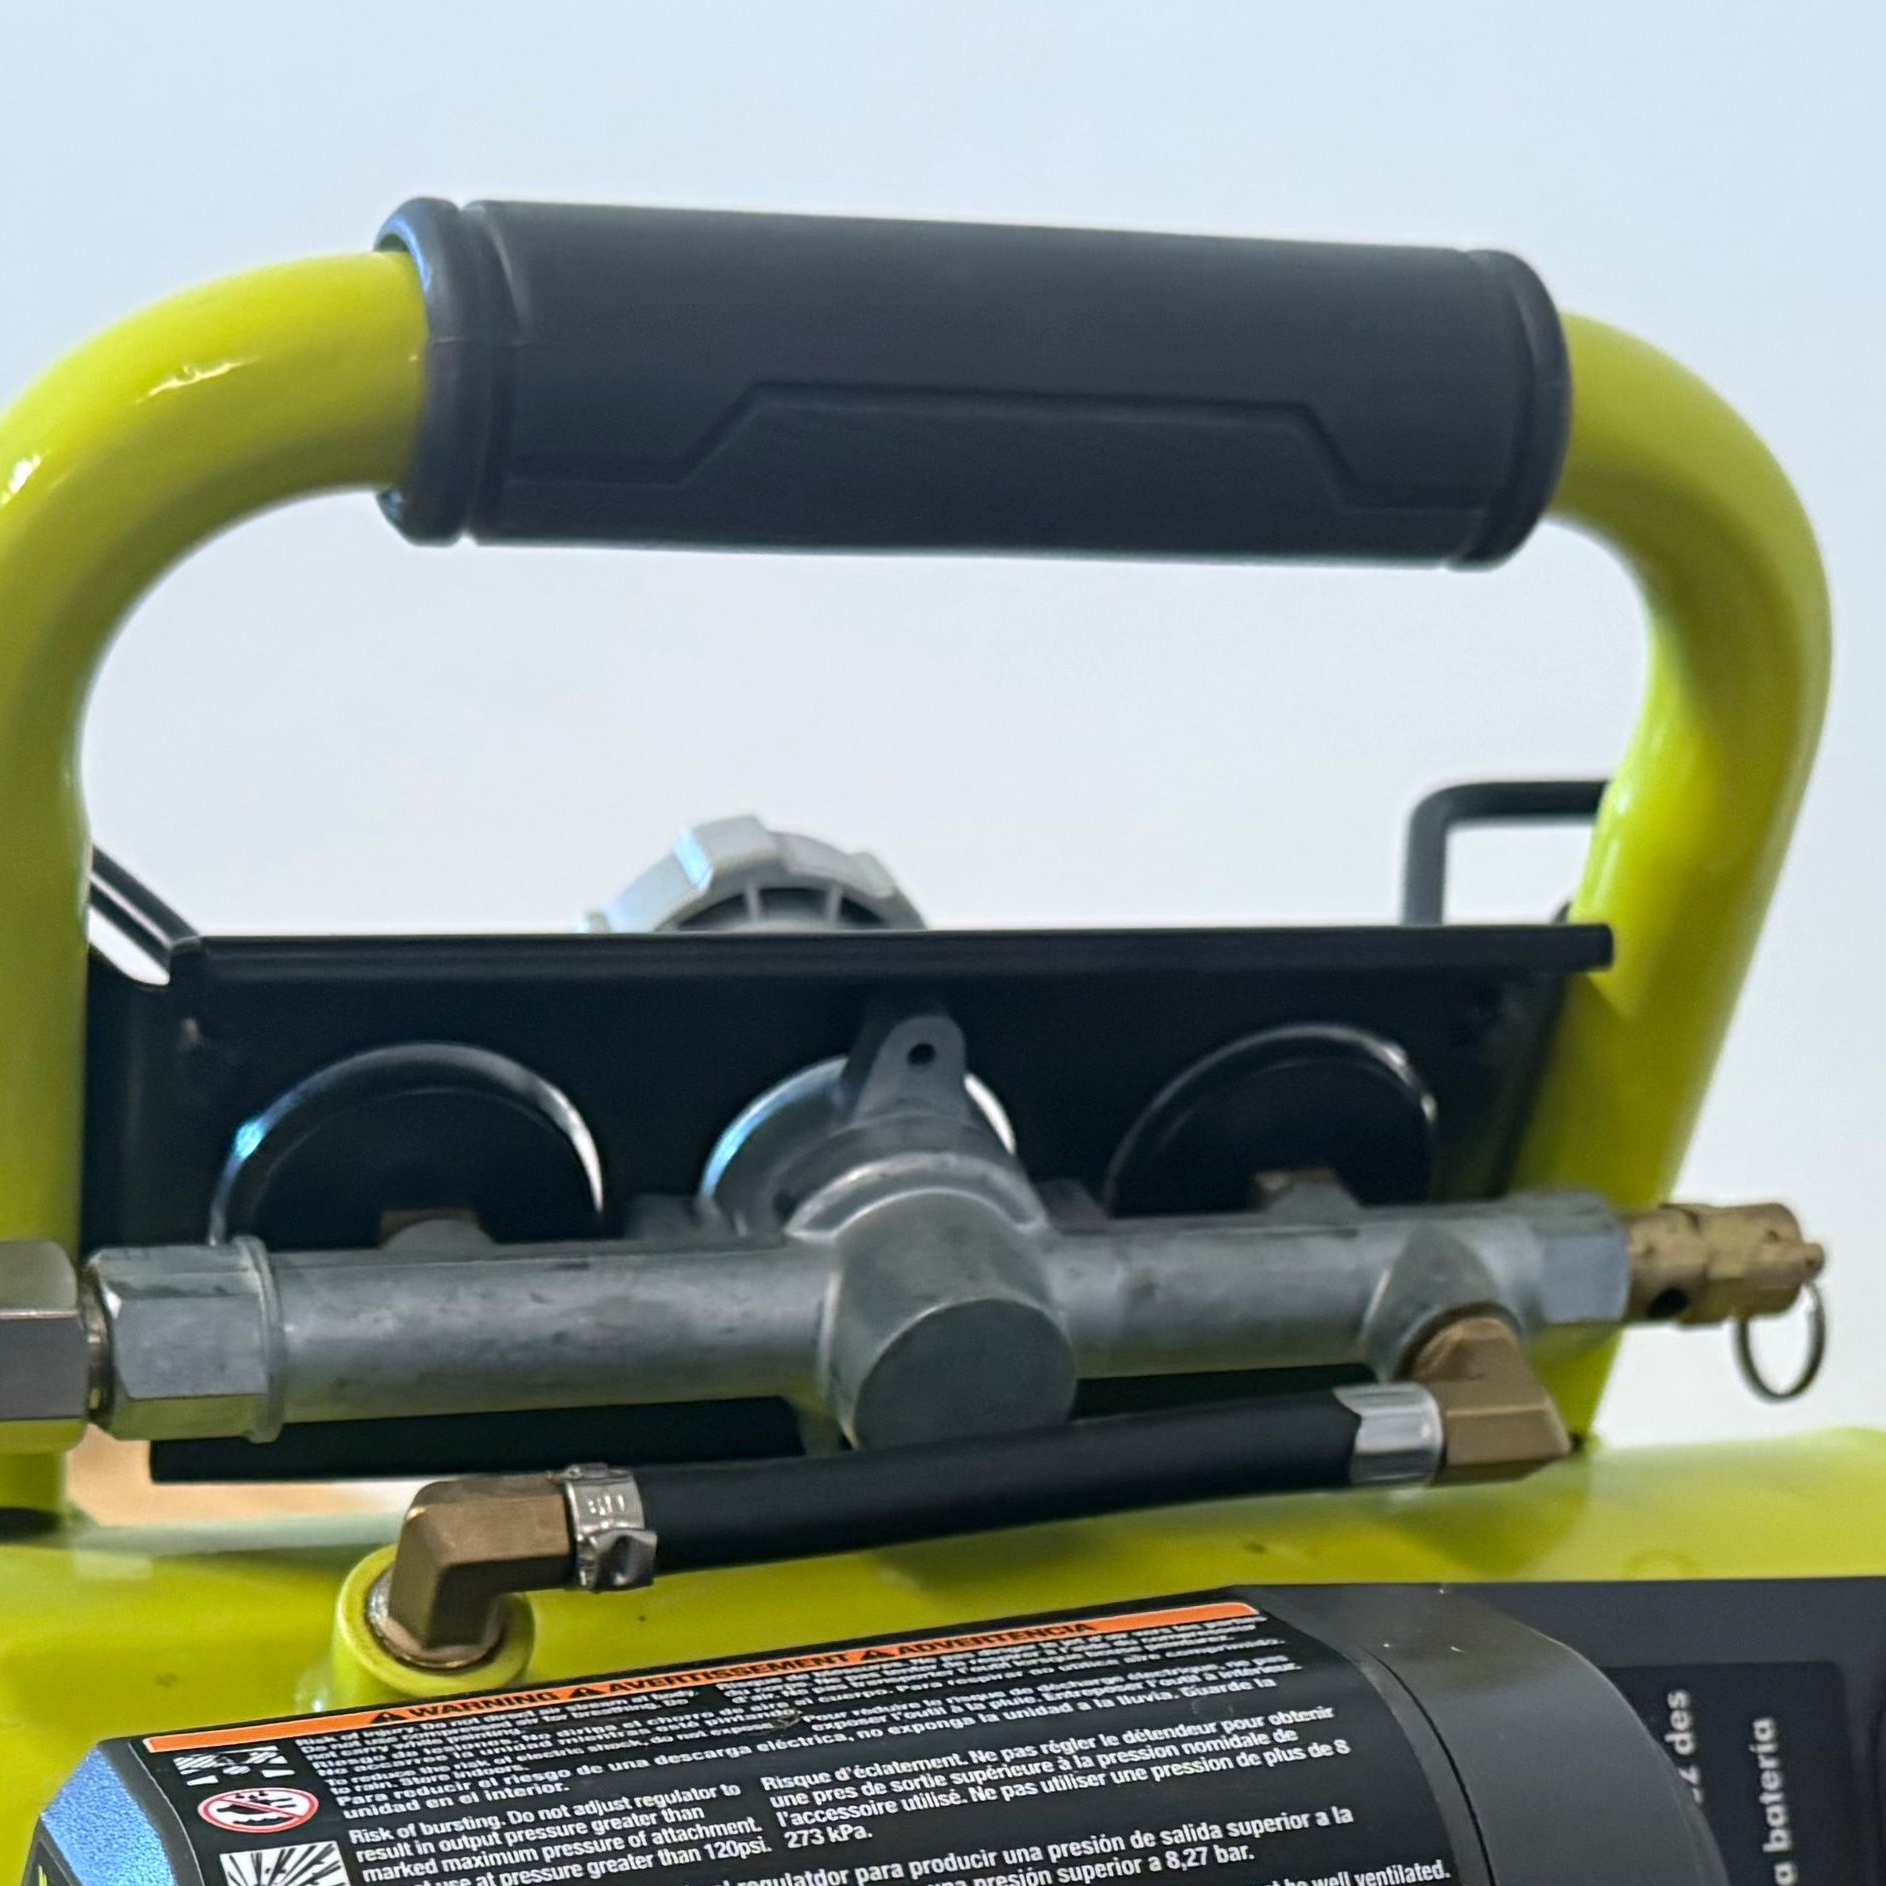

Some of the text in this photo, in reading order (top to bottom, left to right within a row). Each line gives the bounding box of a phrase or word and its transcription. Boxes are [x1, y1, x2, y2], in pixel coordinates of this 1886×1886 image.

[406, 1620, 1095, 1718] WARNING AVERTISSEMENT ADVERTENCIA
[1664, 1689, 1696, 1756] des
[1749, 1717, 1793, 1853] batería
[585, 1852, 655, 1881] greater
[656, 1847, 703, 1868] than
[702, 1834, 774, 1861] 120psi.
[1774, 1862, 1797, 1886] a
